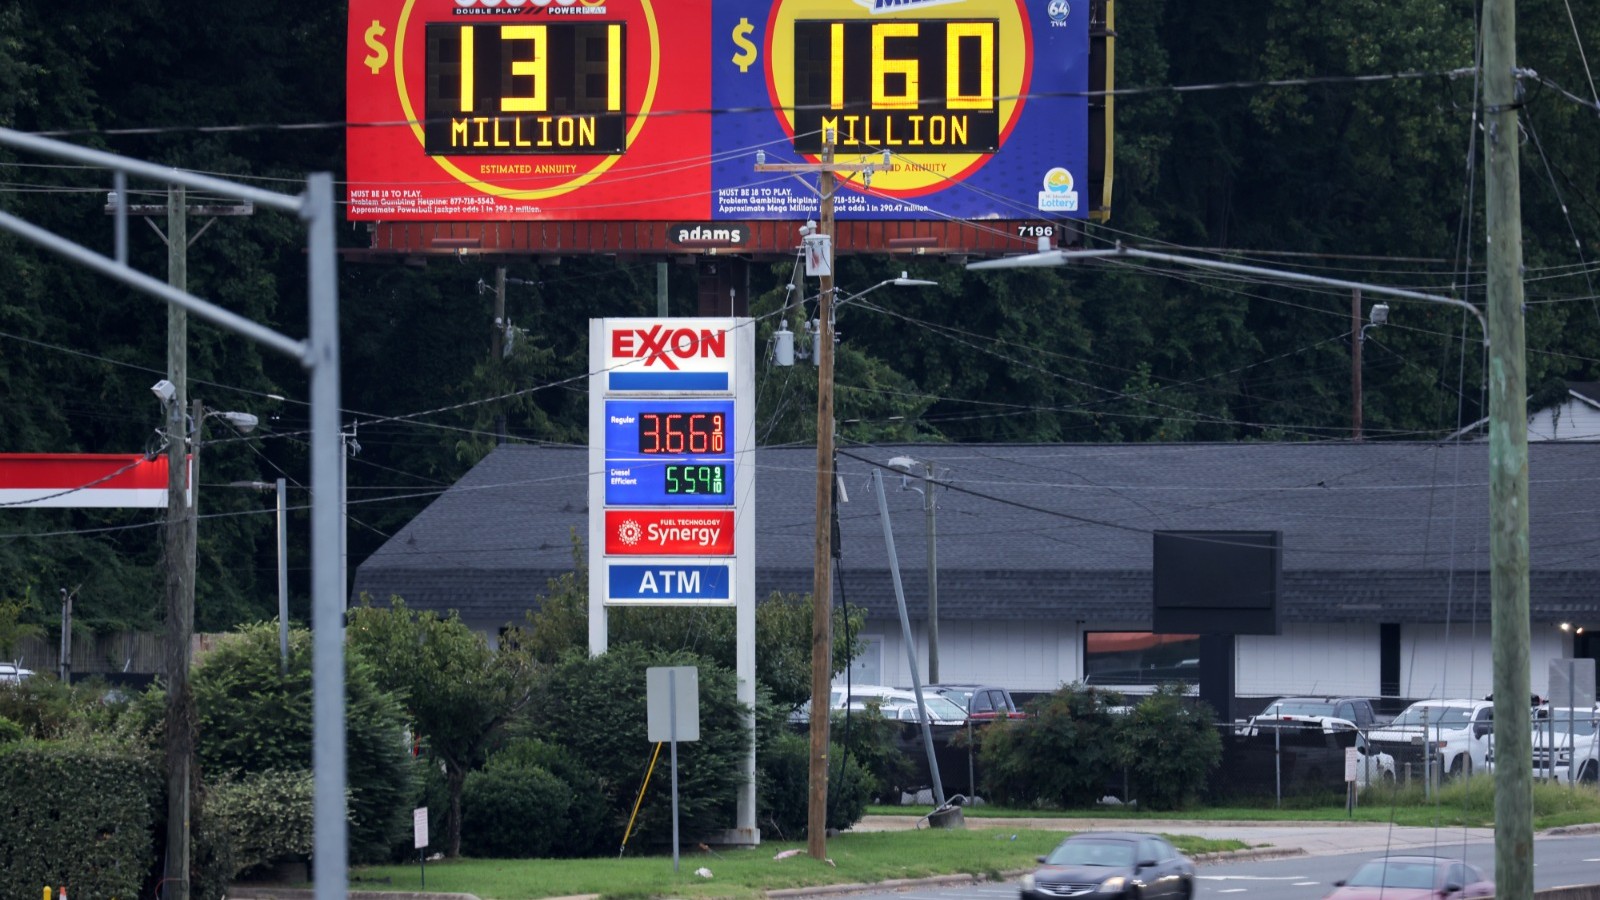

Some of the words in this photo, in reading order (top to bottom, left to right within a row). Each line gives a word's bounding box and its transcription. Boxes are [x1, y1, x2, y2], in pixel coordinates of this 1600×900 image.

[1049, 1, 1068, 16] 64
[363, 20, 389, 74] $
[460, 25, 621, 112] 131
[731, 18, 758, 72] $
[831, 23, 994, 109] 160
[452, 117, 596, 147] MILLION
[821, 116, 968, 145] MILLION
[480, 164, 532, 174] ESTIMATED
[534, 164, 577, 174] ANNUITY
[904, 163, 947, 172] ANNUITY
[350, 190, 370, 198] MUST
[371, 190, 380, 198] BE
[381, 190, 389, 198] 18
[390, 190, 402, 198] TO
[403, 190, 423, 198] PLAY.
[718, 188, 739, 197] MUST
[740, 188, 750, 197] BE
[751, 188, 760, 197] 18
[761, 188, 772, 197] TO
[773, 188, 793, 197] PLAY.
[350, 198, 379, 206] Problem
[380, 198, 416, 207] Gambling
[417, 198, 449, 207] Helpline:
[450, 197, 496, 205] 877-718-5543.
[718, 196, 748, 205] Problem
[749, 196, 786, 206] Gambling
[787, 196, 819, 206] Helpline:
[1041, 199, 1075, 209] Lottery
[351, 206, 395, 214] Approximate
[495, 205, 514, 213] 292.2
[718, 204, 766, 214] Approximate
[767, 204, 788, 213] Mega
[789, 204, 818, 212] Millions
[847, 204, 866, 212] odds
[880, 204, 903, 212] 290.47
[678, 225, 741, 243] adams
[1018, 226, 1053, 237] 7196
[611, 324, 726, 371] EXXON
[610, 415, 635, 425] Regular
[643, 414, 708, 453] 3.66
[610, 468, 630, 476] Diesel
[610, 477, 638, 485] Efficient
[647, 523, 721, 546] Synergy
[638, 570, 701, 594] ATM
